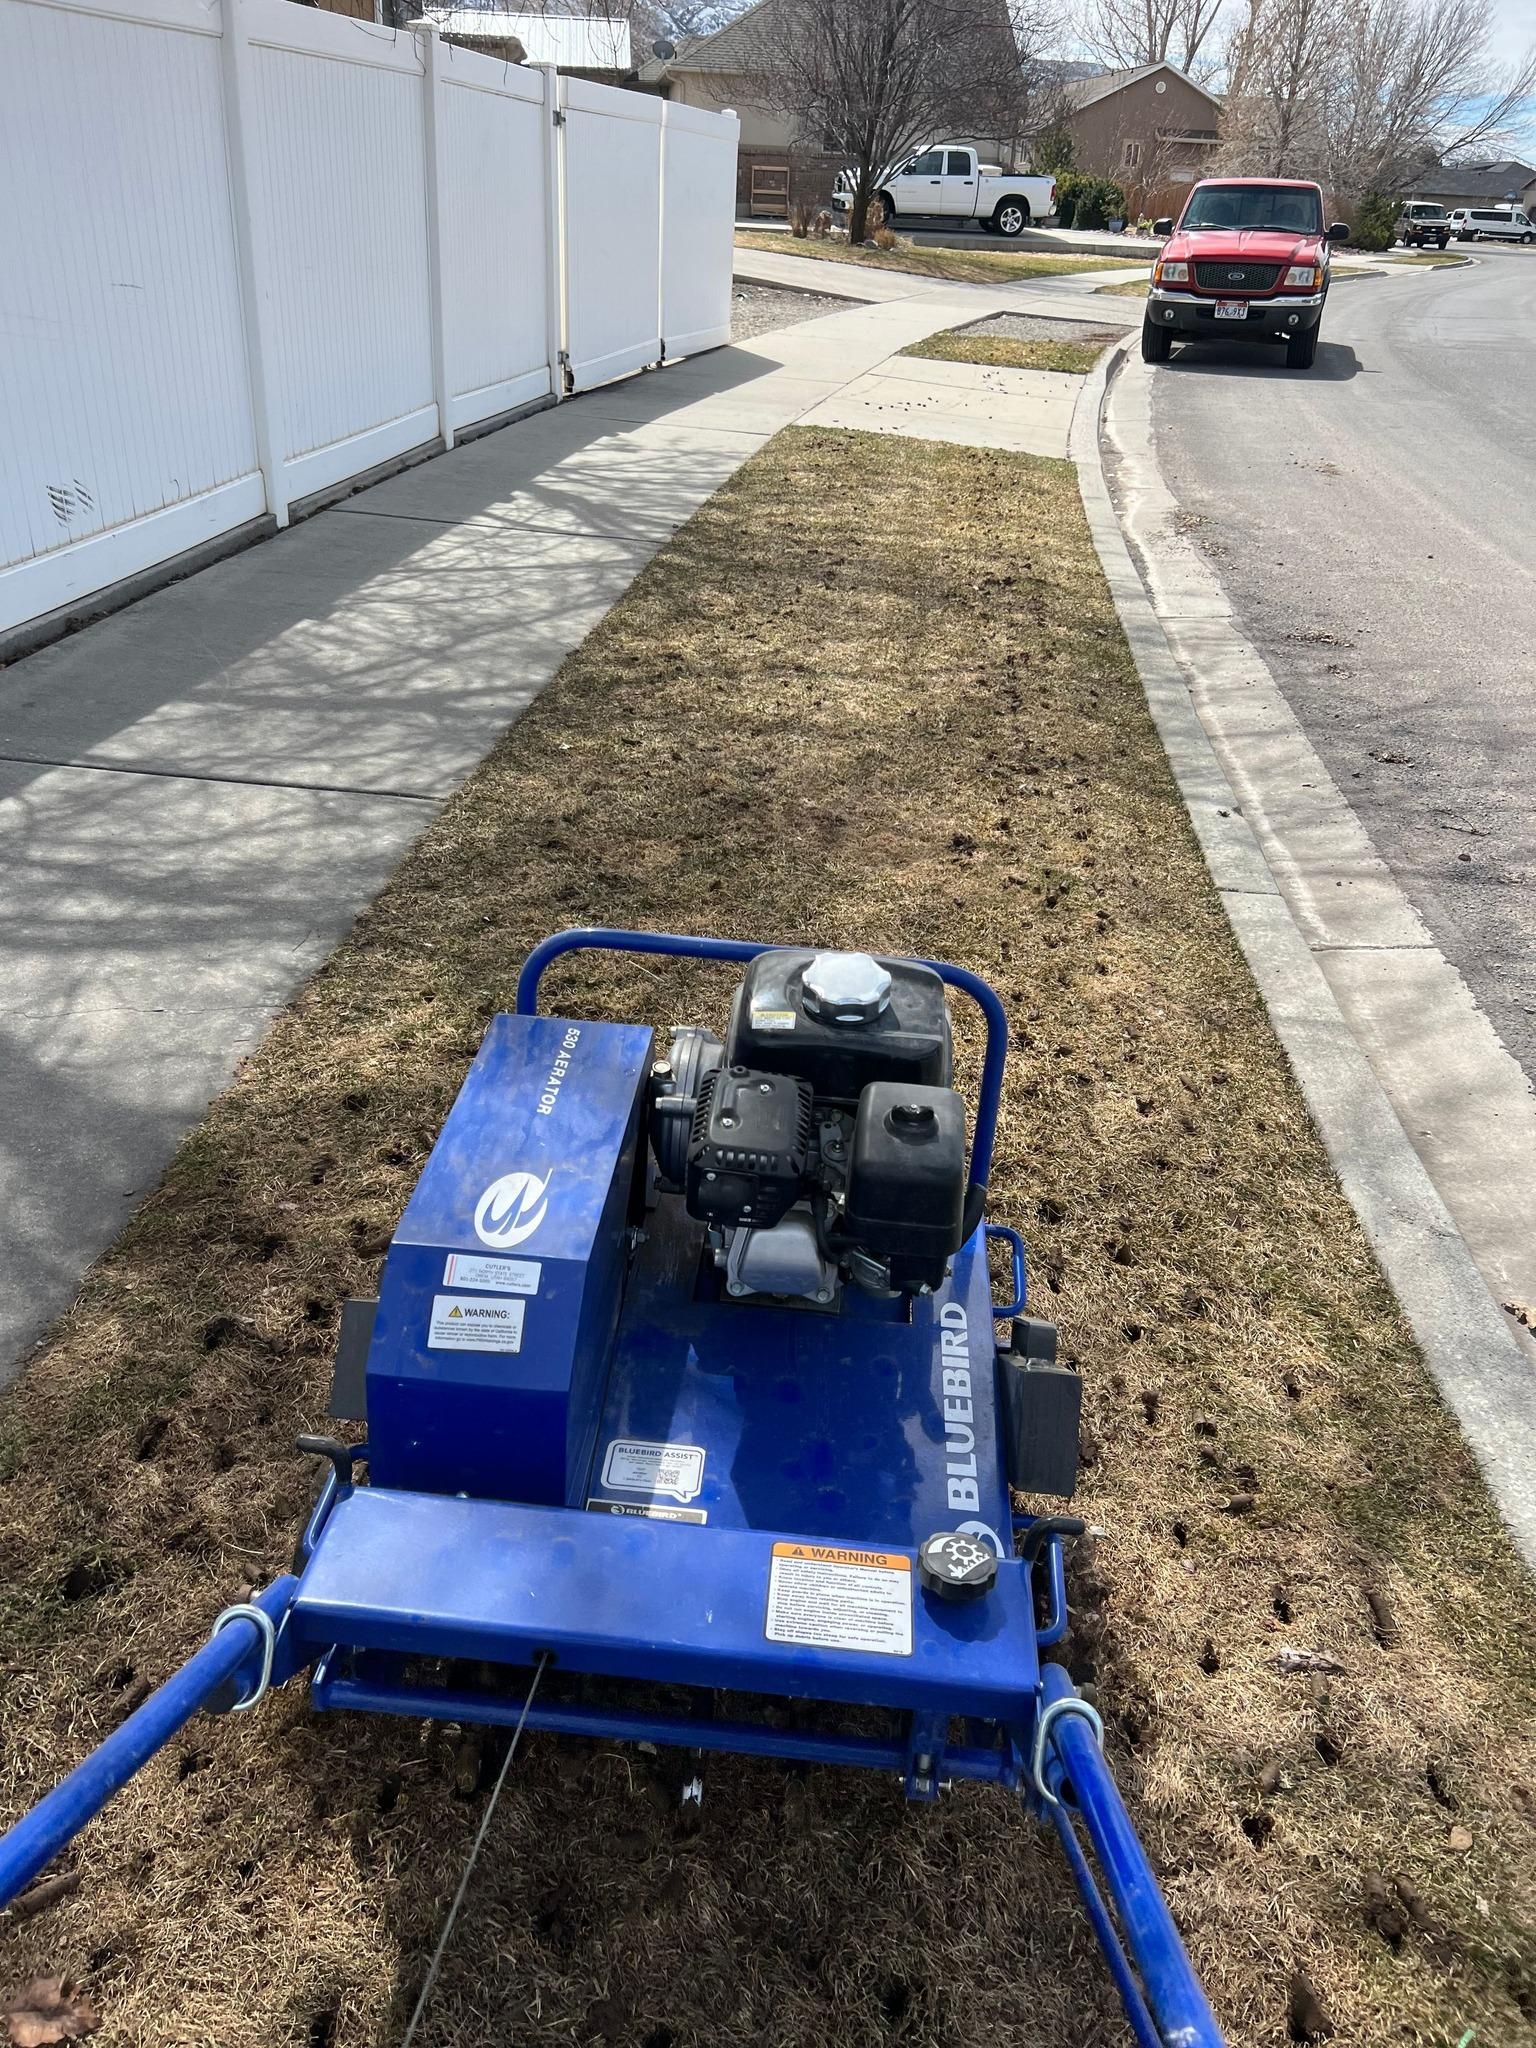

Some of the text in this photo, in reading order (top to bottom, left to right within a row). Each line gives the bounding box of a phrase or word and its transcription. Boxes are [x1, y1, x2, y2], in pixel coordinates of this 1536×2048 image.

[536, 1027, 581, 1115] 530 AERATOR
[464, 1308, 510, 1320] WARNING:
[940, 1302, 980, 1512] BLUEBIRD
[618, 1447, 662, 1457] BLUEBIRD
[811, 1547, 888, 1566] WARNING
